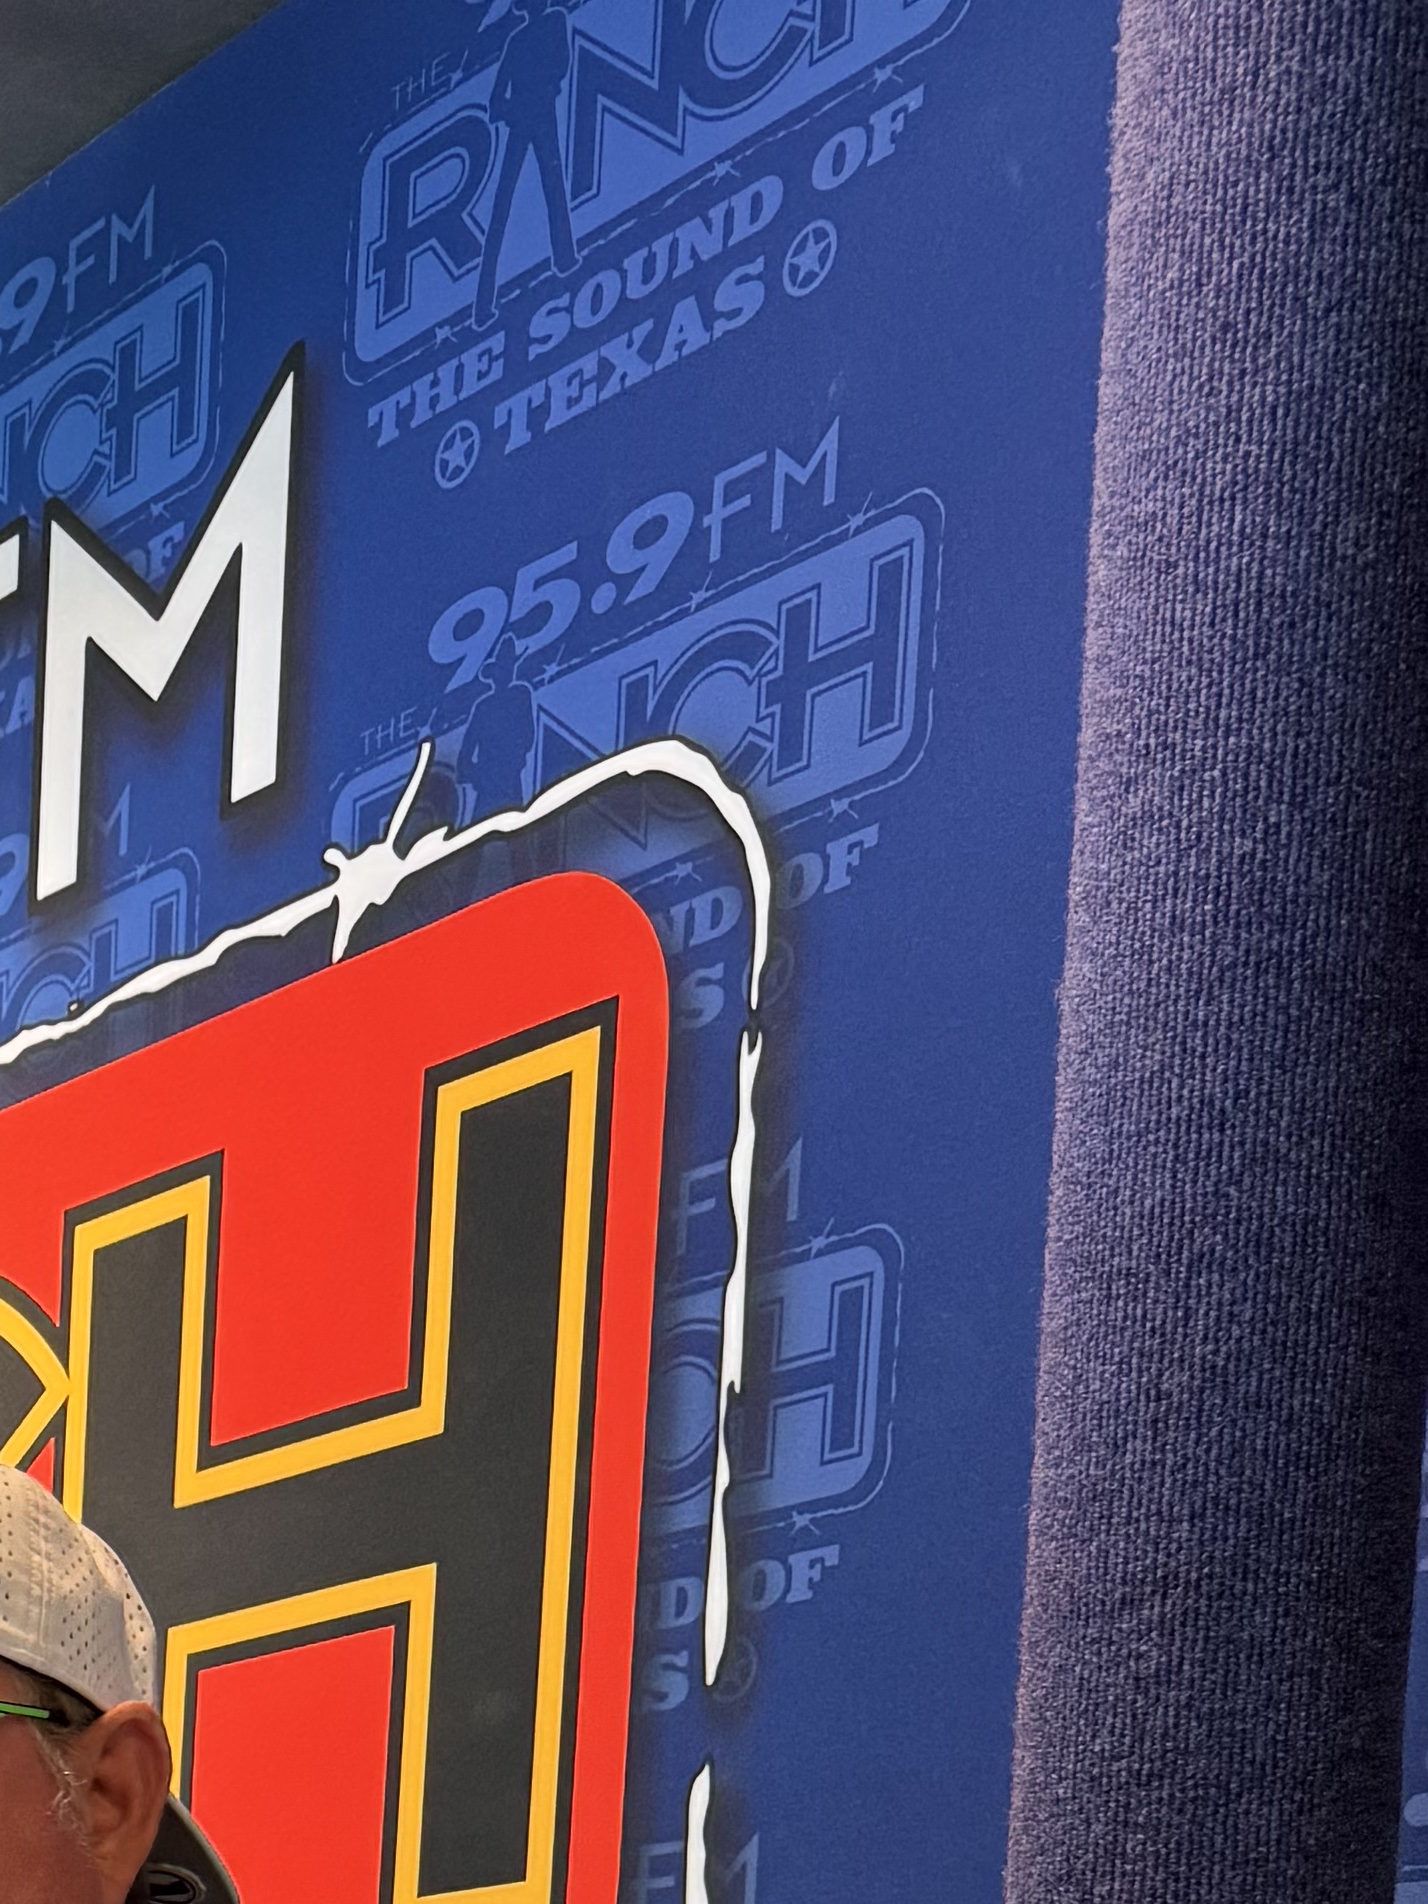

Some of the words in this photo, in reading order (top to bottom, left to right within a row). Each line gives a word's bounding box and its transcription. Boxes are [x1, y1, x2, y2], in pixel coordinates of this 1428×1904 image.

[391, 51, 451, 110] THE
[367, 331, 505, 448] THE
[528, 174, 784, 362] SOUND
[811, 84, 925, 192] OF
[494, 253, 767, 455] TEXAS
[359, 709, 416, 757] THE
